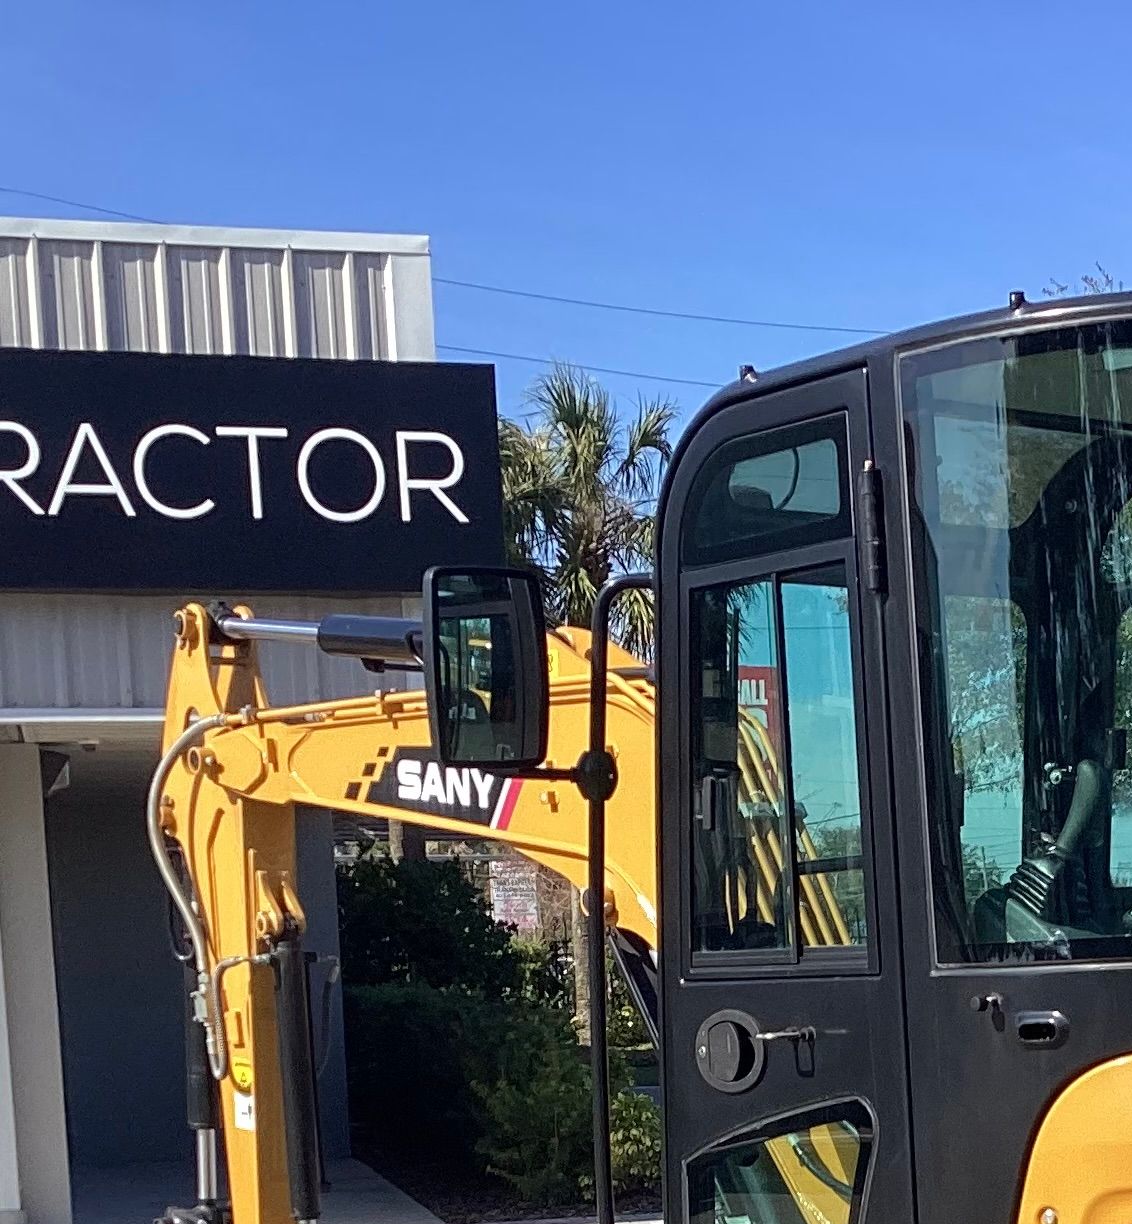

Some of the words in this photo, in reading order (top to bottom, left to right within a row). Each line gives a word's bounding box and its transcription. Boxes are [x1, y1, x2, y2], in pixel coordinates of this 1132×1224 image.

[0, 420, 471, 524] RACTOR
[738, 679, 769, 705] ALL
[396, 758, 495, 809] SANY
